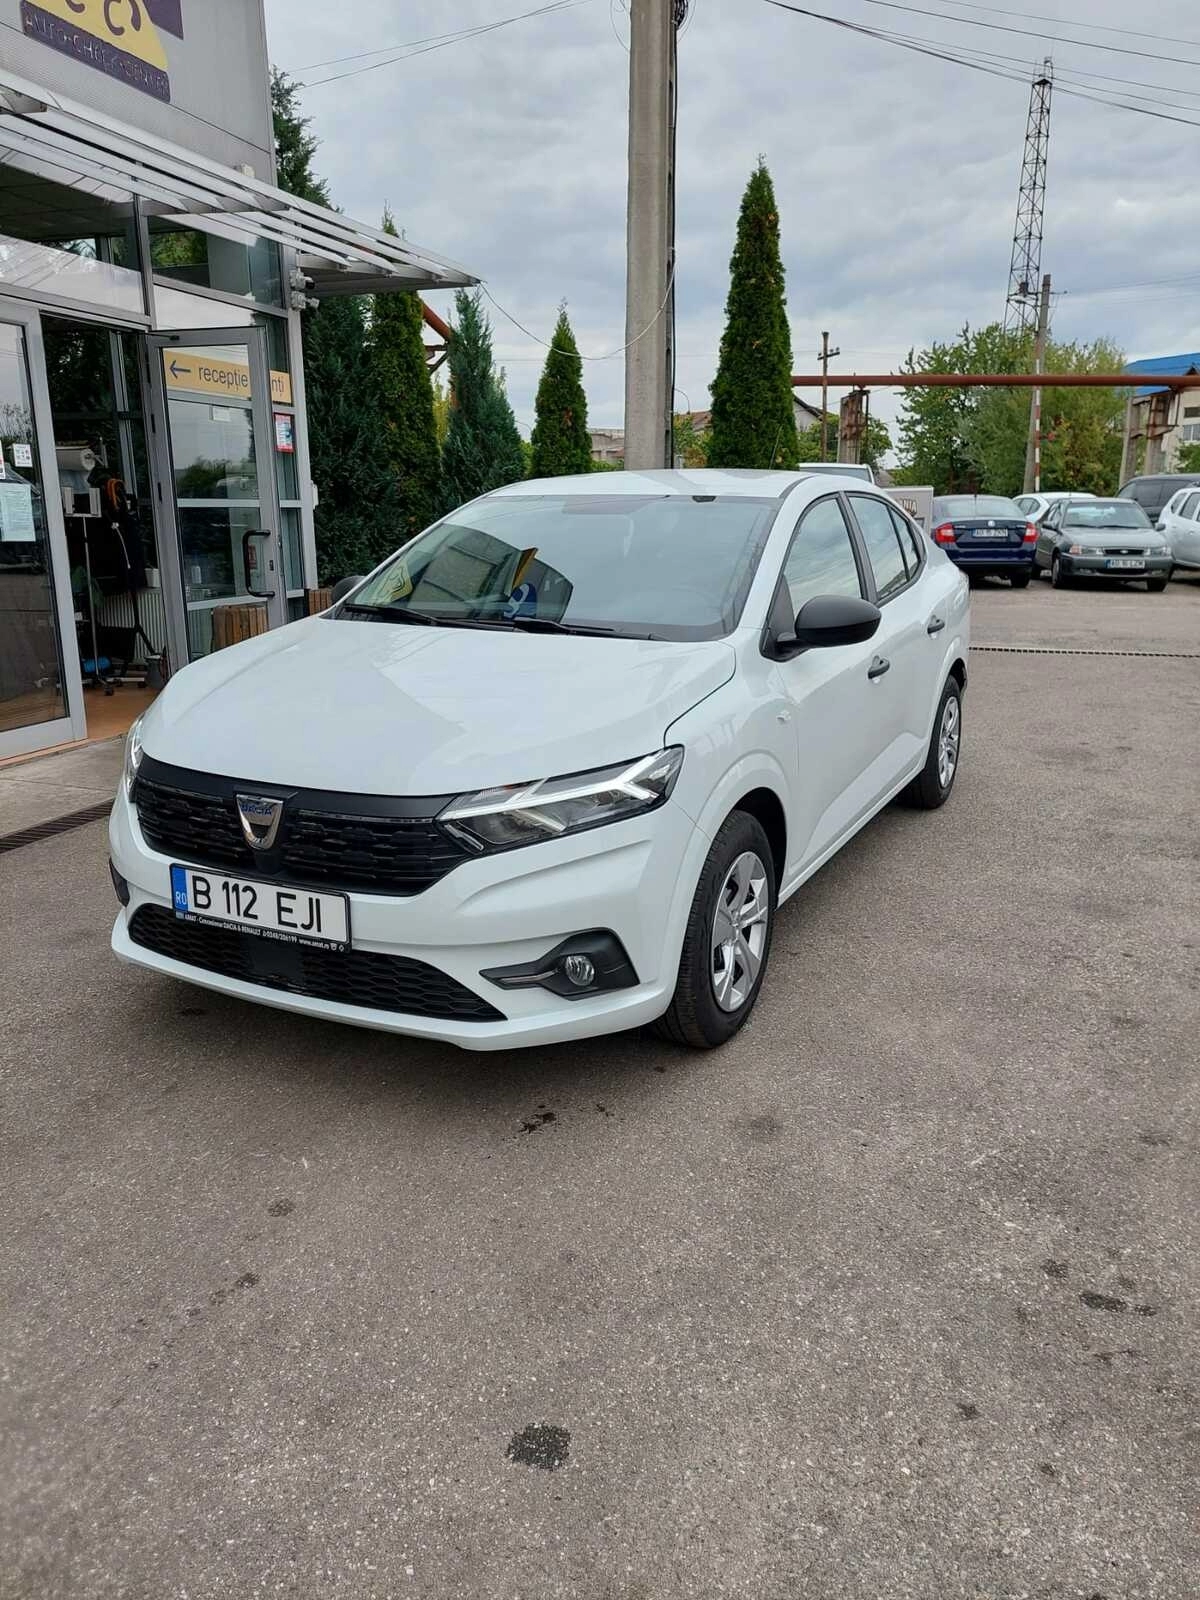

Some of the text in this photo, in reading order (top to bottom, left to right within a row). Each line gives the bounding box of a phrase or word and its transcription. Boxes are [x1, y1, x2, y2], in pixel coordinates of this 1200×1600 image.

[199, 367, 249, 392] recepție
[240, 803, 273, 816] DACIA
[175, 891, 187, 905] RO
[192, 875, 321, 932] B 112 EJI
